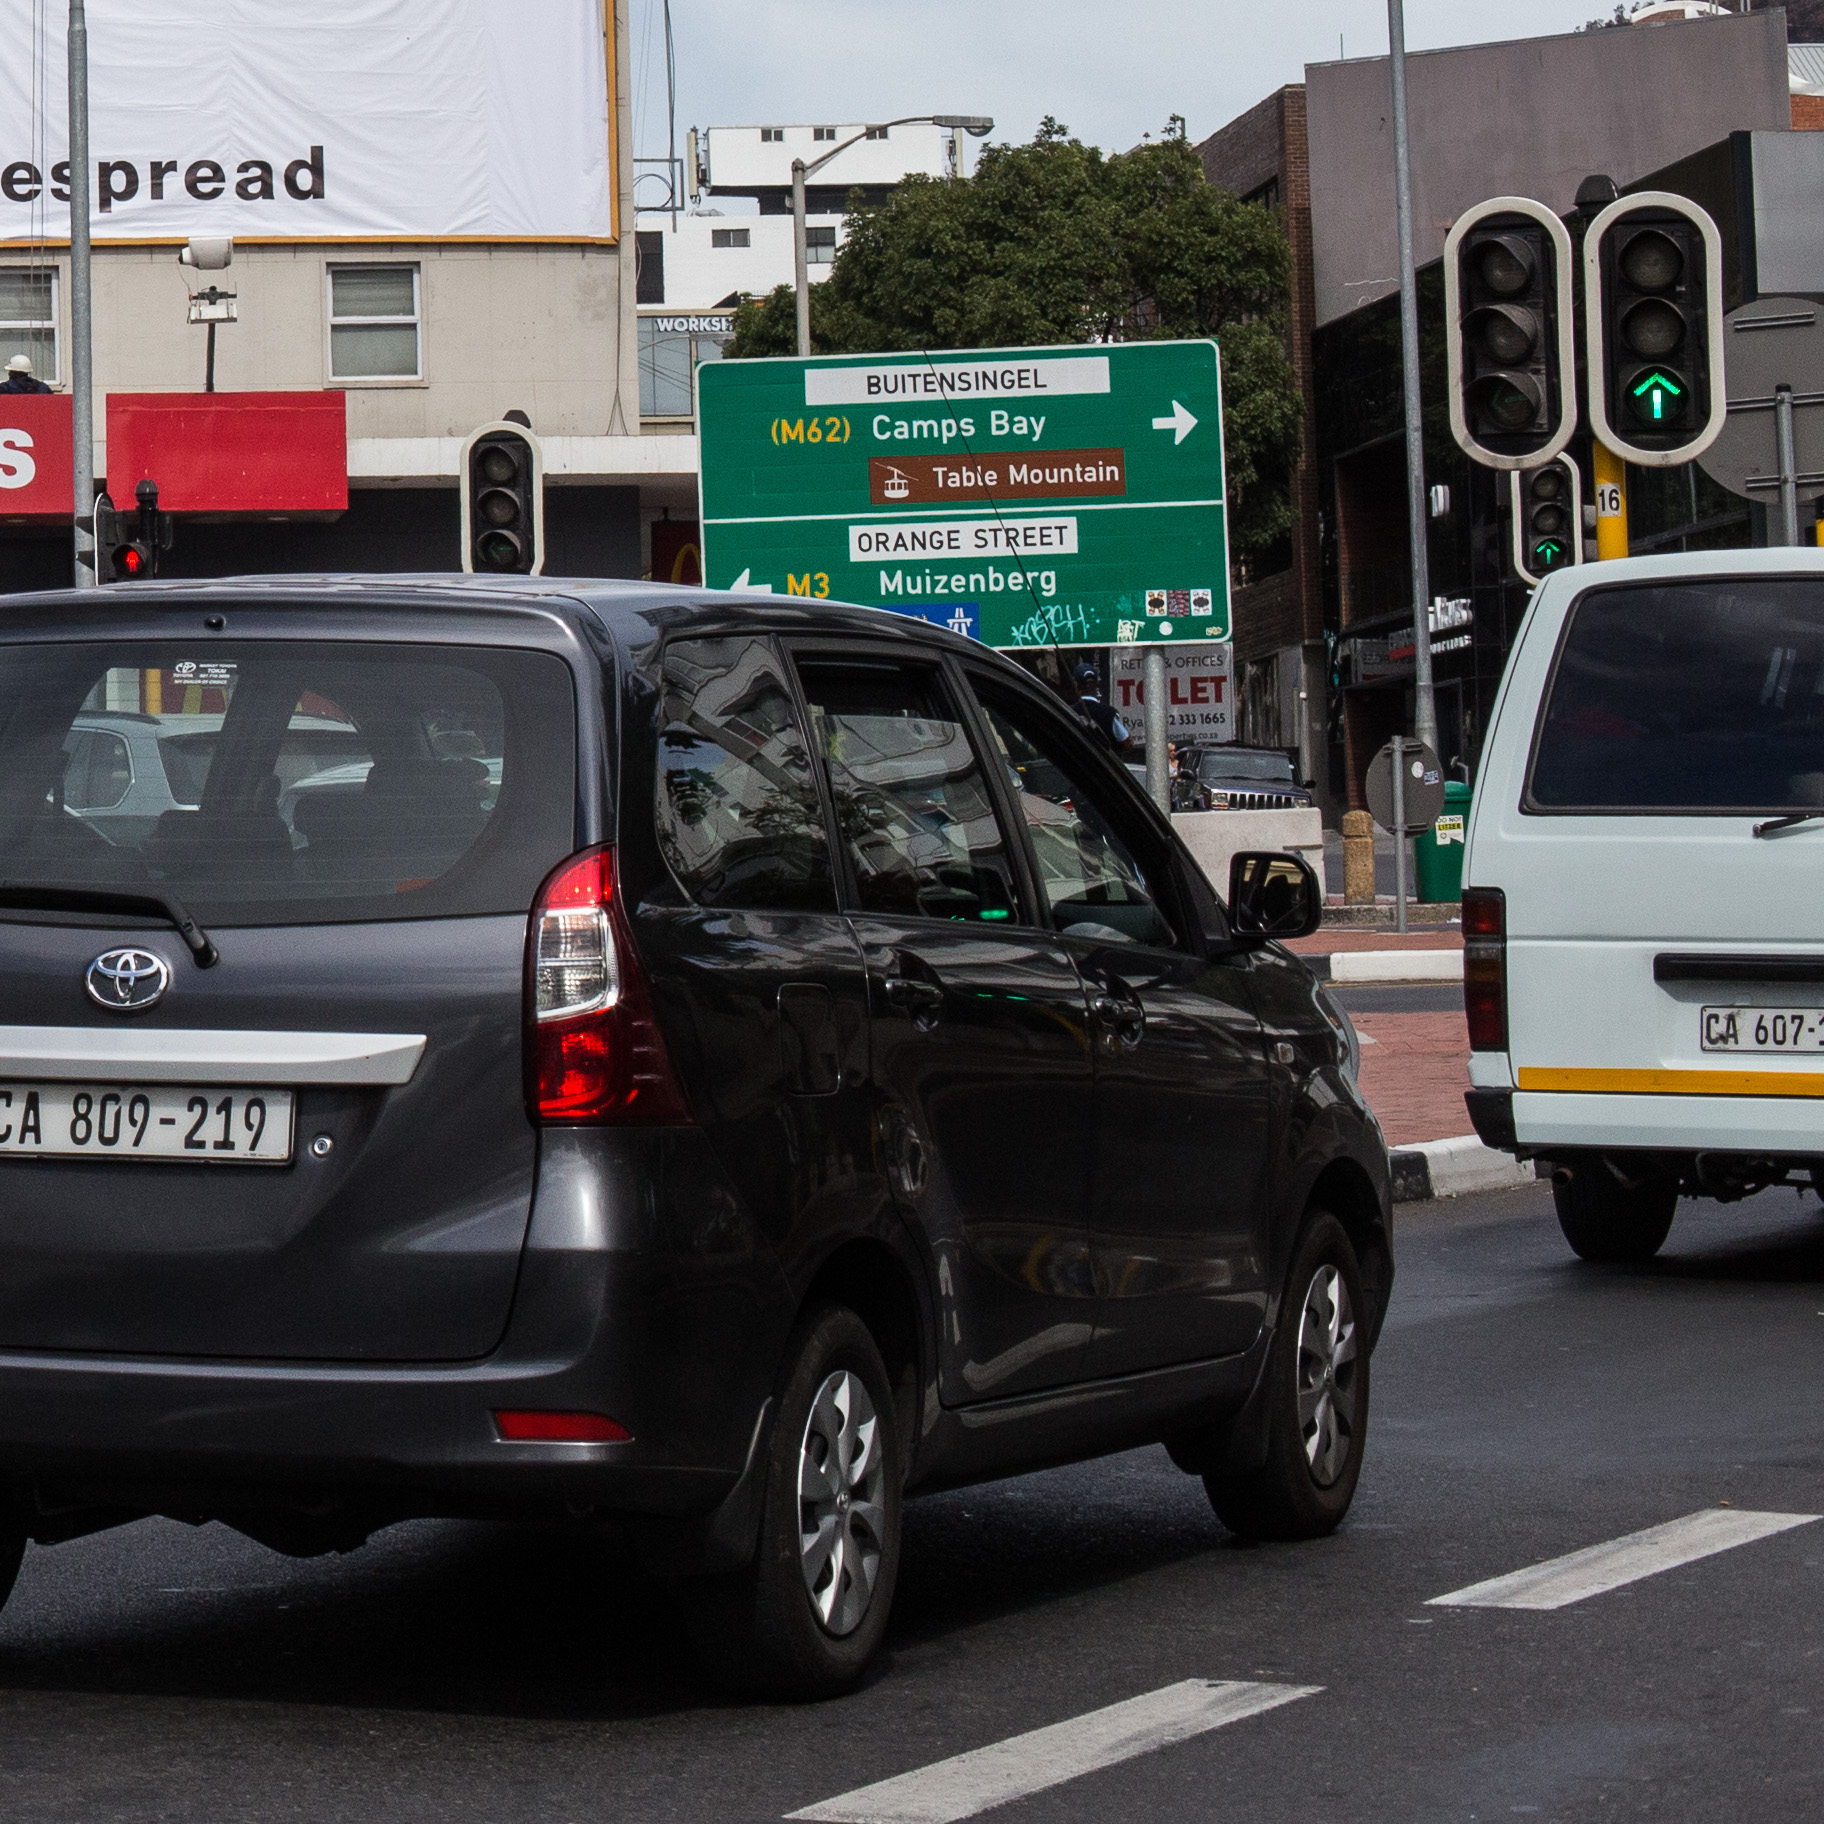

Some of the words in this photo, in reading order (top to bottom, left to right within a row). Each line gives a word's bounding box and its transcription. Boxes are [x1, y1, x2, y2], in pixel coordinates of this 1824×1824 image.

[867, 369, 1047, 395] BUITENSINGEL
[771, 416, 850, 445] (M62)
[872, 415, 976, 444] Camps
[990, 410, 1046, 442] Bay
[933, 466, 997, 488] Table
[1009, 461, 1119, 485] Mountain
[1598, 489, 1620, 512] 16
[857, 530, 961, 553] ORANGE
[974, 526, 1068, 548] STREET
[787, 572, 830, 598] M3
[880, 566, 1056, 595] Muizenberg
[1175, 656, 1224, 668] OFFICES
[1169, 676, 1227, 705] LET
[1179, 714, 1196, 725] 333
[1202, 712, 1225, 725] 1665
[1705, 1013, 1739, 1045] CA
[69, 1092, 266, 1152] 809-219
